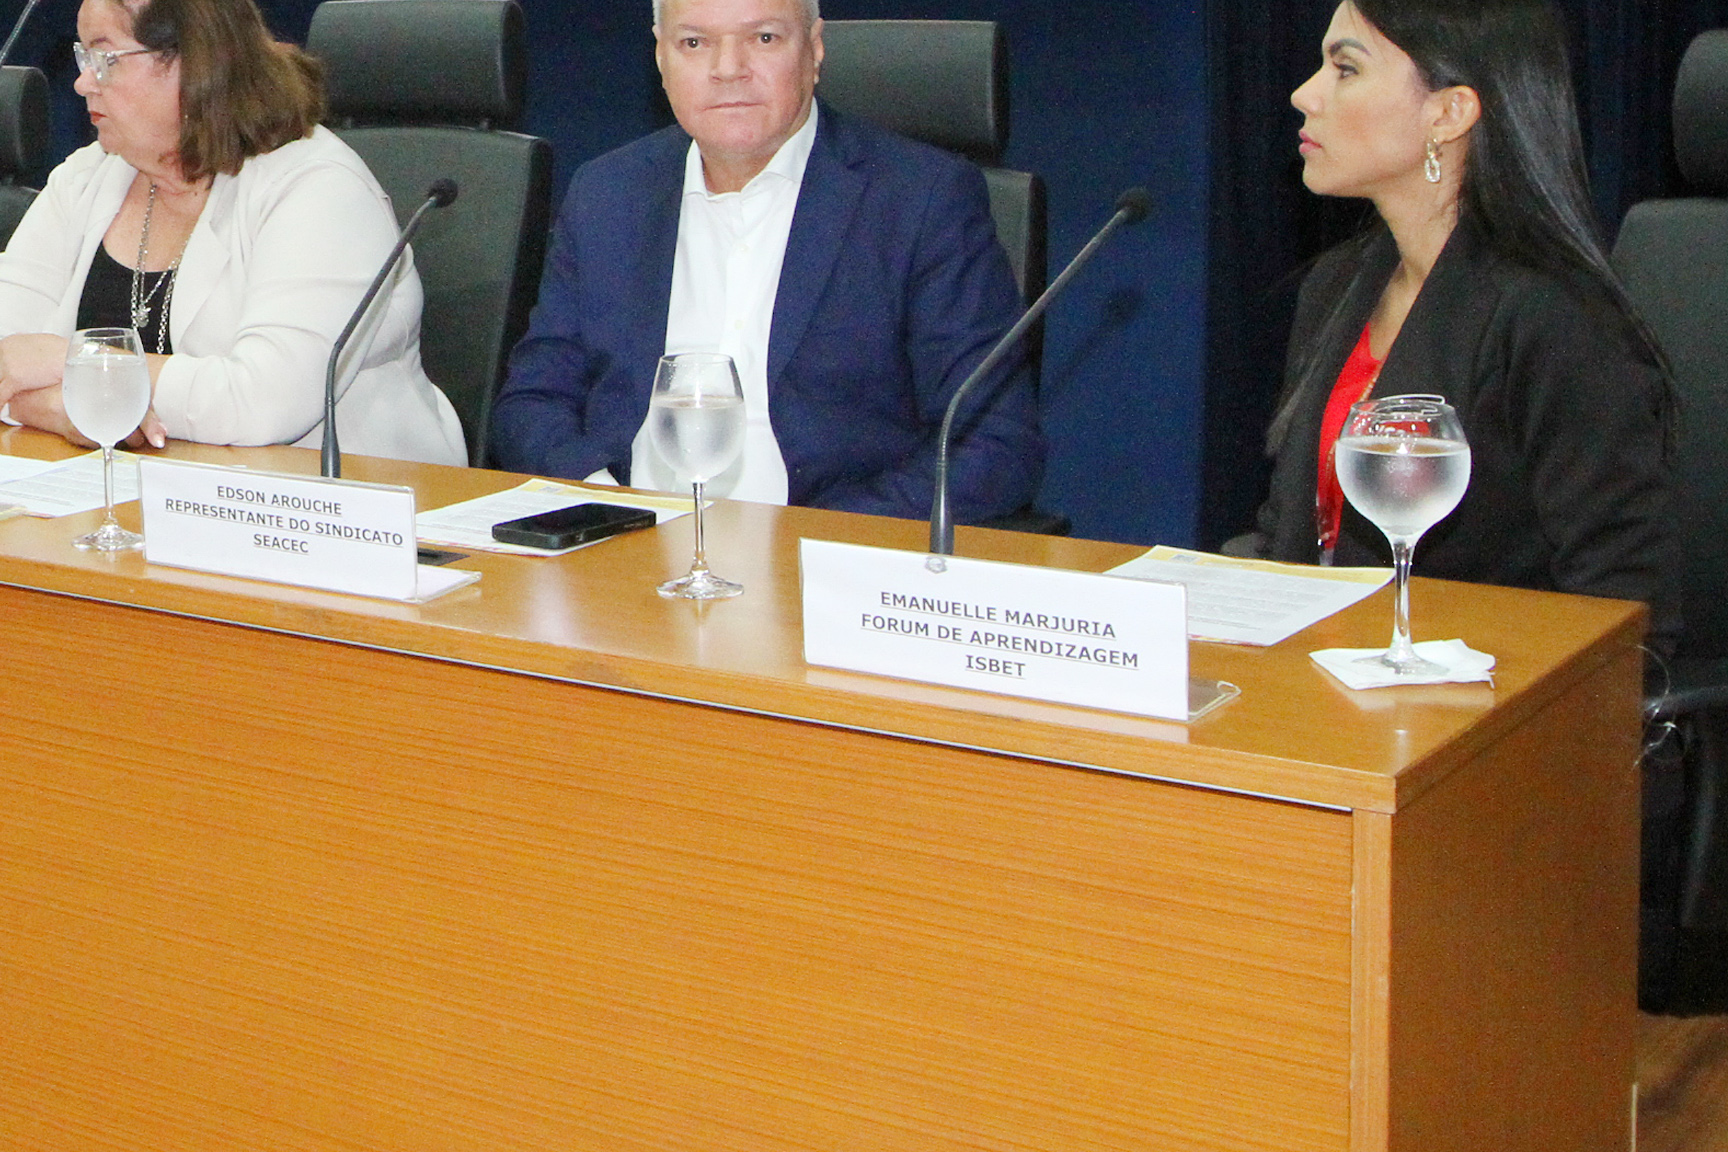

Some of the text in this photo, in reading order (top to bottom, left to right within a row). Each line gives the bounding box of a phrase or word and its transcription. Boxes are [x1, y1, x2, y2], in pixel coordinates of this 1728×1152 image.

[217, 485, 342, 516] EDSON AROUCHE
[165, 498, 404, 546] REPRESENTANTE DO SINDICATO
[253, 533, 309, 554] SEACEC
[880, 592, 1116, 638] EMANUELLE MARJURIA
[861, 614, 1139, 668] FORUM DE APRENDIZAGEM
[965, 654, 1026, 677] ISBET
